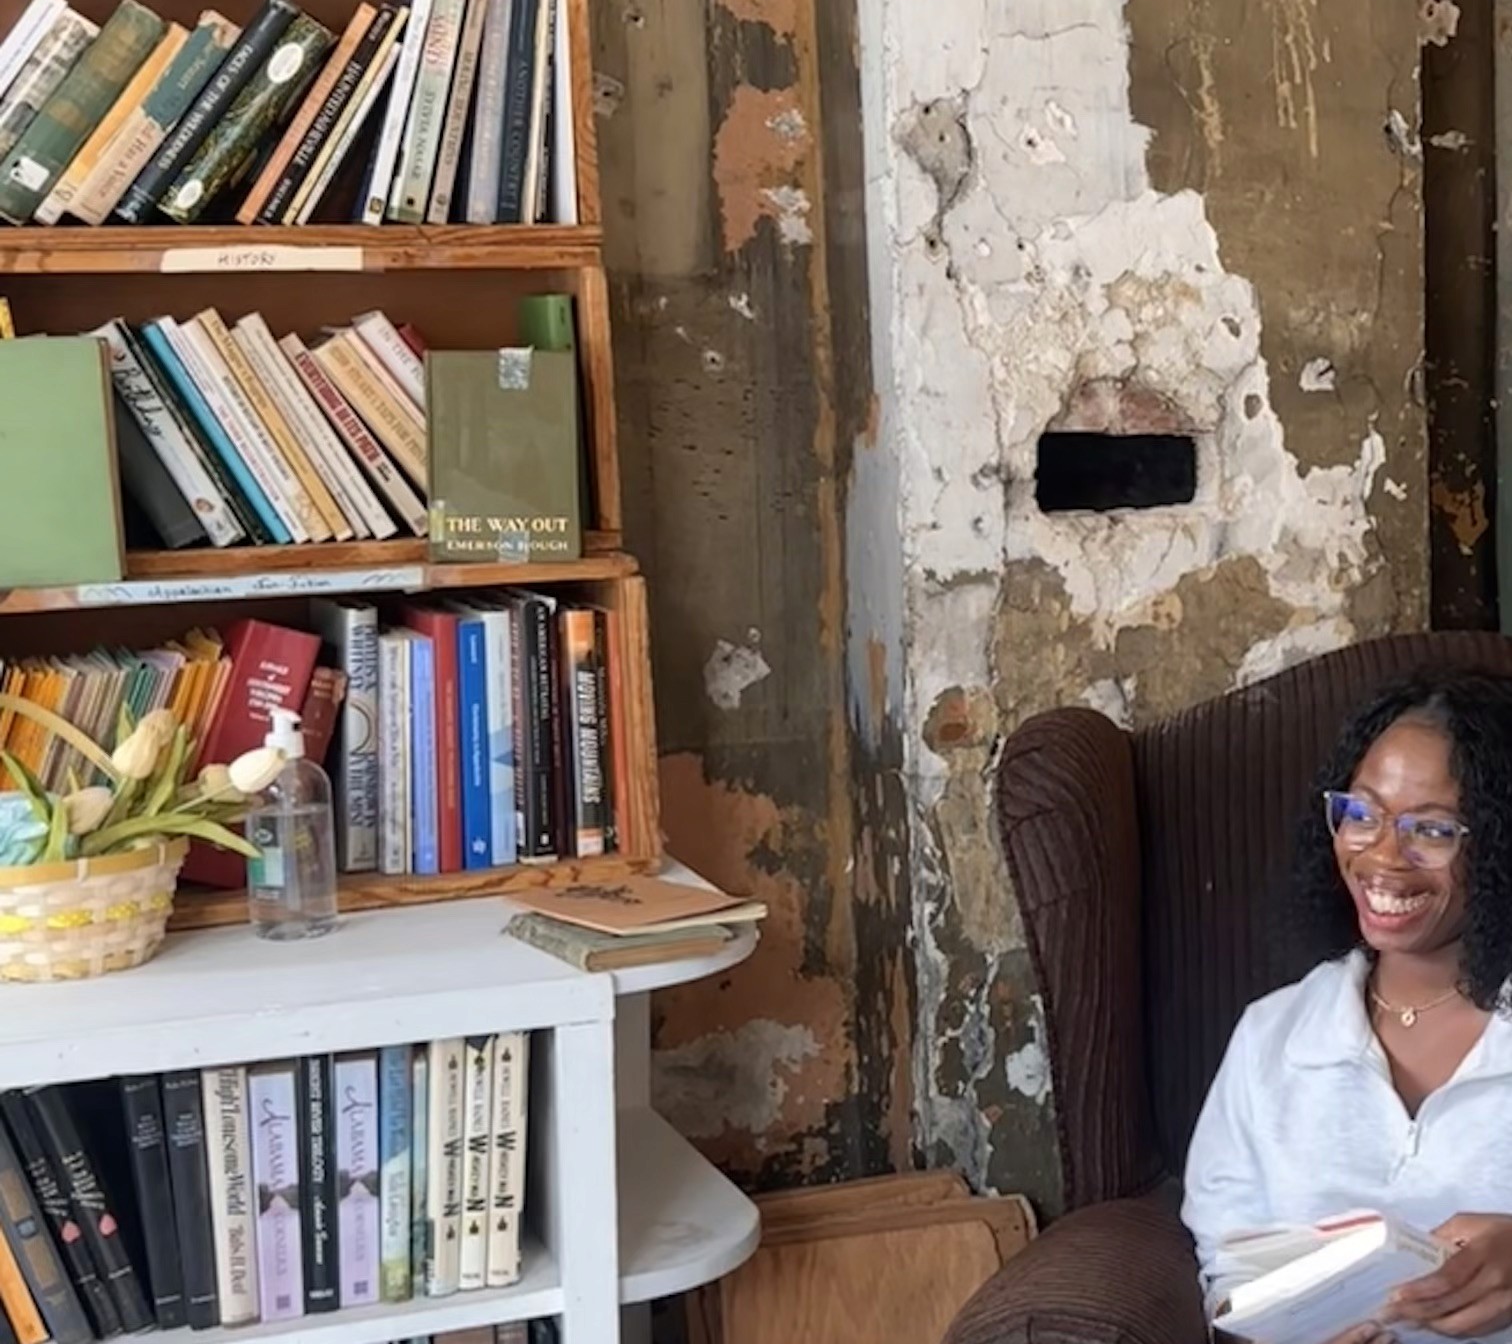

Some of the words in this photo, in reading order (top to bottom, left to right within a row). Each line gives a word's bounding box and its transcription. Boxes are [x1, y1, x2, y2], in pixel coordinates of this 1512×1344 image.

[390, 342, 412, 365] THE
[293, 349, 343, 413] EVERYTHING
[342, 417, 362, 439] ITS
[354, 433, 381, 464] PATH
[446, 516, 482, 533] THE
[487, 516, 531, 533] WAY
[531, 516, 569, 533] OUT
[446, 541, 512, 552] EMERSON
[348, 626, 364, 690] WHITNEY
[576, 670, 597, 724] MOVING
[578, 725, 601, 803] MOUNTAINS
[214, 1070, 240, 1105] High
[219, 1104, 244, 1174] Lonesome
[310, 1135, 325, 1183] TRILOGY
[223, 1173, 247, 1216] World
